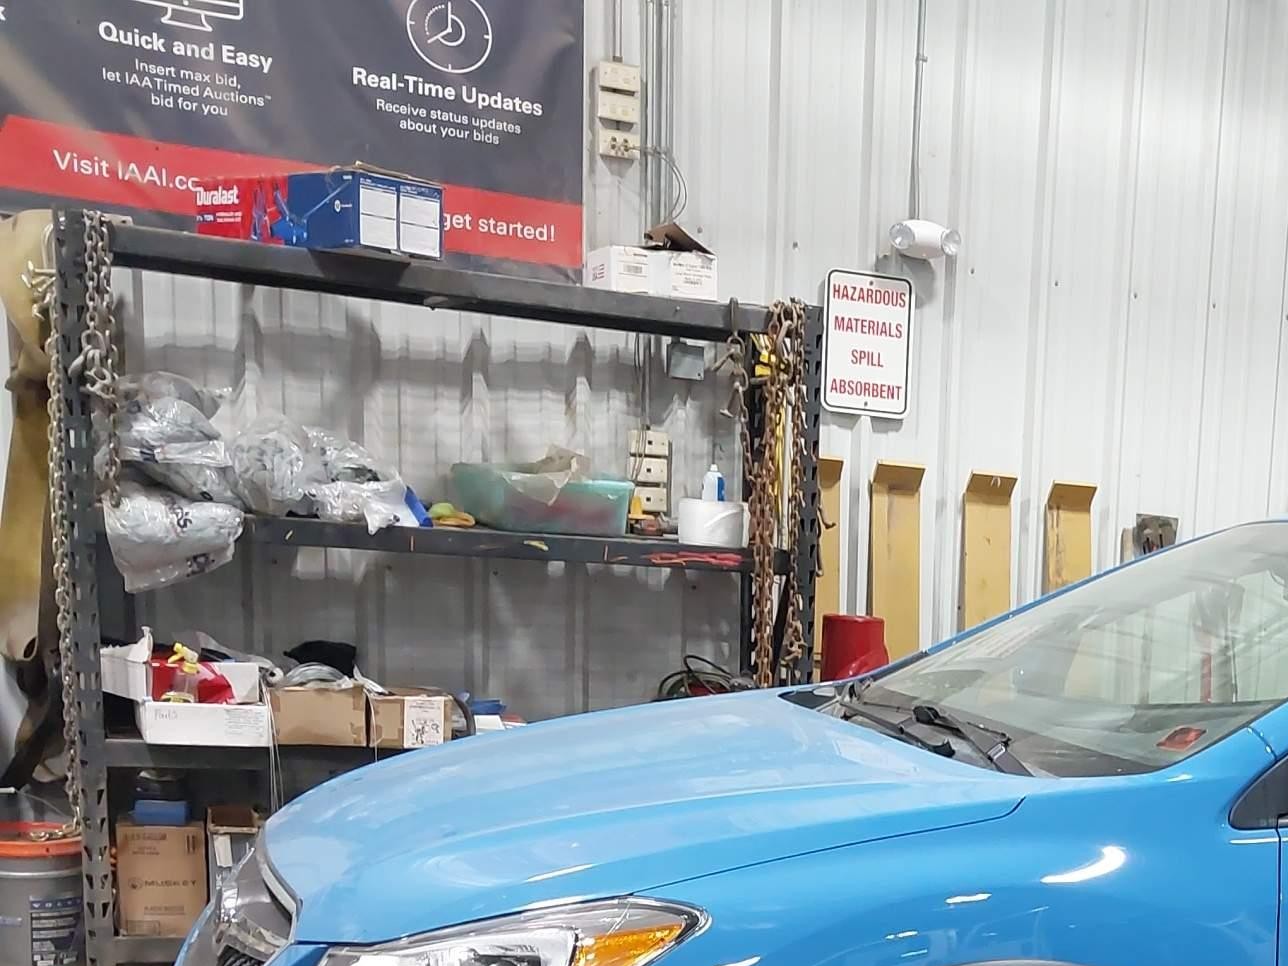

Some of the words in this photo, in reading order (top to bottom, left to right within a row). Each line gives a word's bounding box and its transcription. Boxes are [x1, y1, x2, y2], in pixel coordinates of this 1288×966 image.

[98, 20, 166, 53] Quick
[172, 41, 214, 60] and
[221, 44, 273, 73] Easy
[102, 67, 120, 83] let
[125, 70, 152, 89] IAA
[154, 78, 199, 97] Timed
[135, 58, 176, 78] Insert
[180, 68, 211, 83] max
[215, 73, 241, 90] bid,
[151, 93, 173, 108] bid
[177, 97, 198, 111] for
[202, 103, 228, 116] you
[352, 66, 456, 101] Real-Time
[461, 85, 544, 117] Updates
[376, 98, 427, 118] Receive
[430, 111, 469, 125] status
[472, 116, 521, 134] updates
[399, 118, 437, 135] about
[440, 125, 470, 140] your
[473, 128, 500, 145] bids
[52, 149, 110, 178] Visit
[117, 160, 202, 192] IAAI.co
[196, 185, 240, 206] Duralast
[443, 212, 472, 232] get
[478, 217, 555, 242] started!
[833, 284, 906, 308] HAZARDOUS
[833, 315, 903, 339] MATERIALS
[851, 349, 884, 368] SPILL
[830, 378, 903, 401] ABSORBENT
